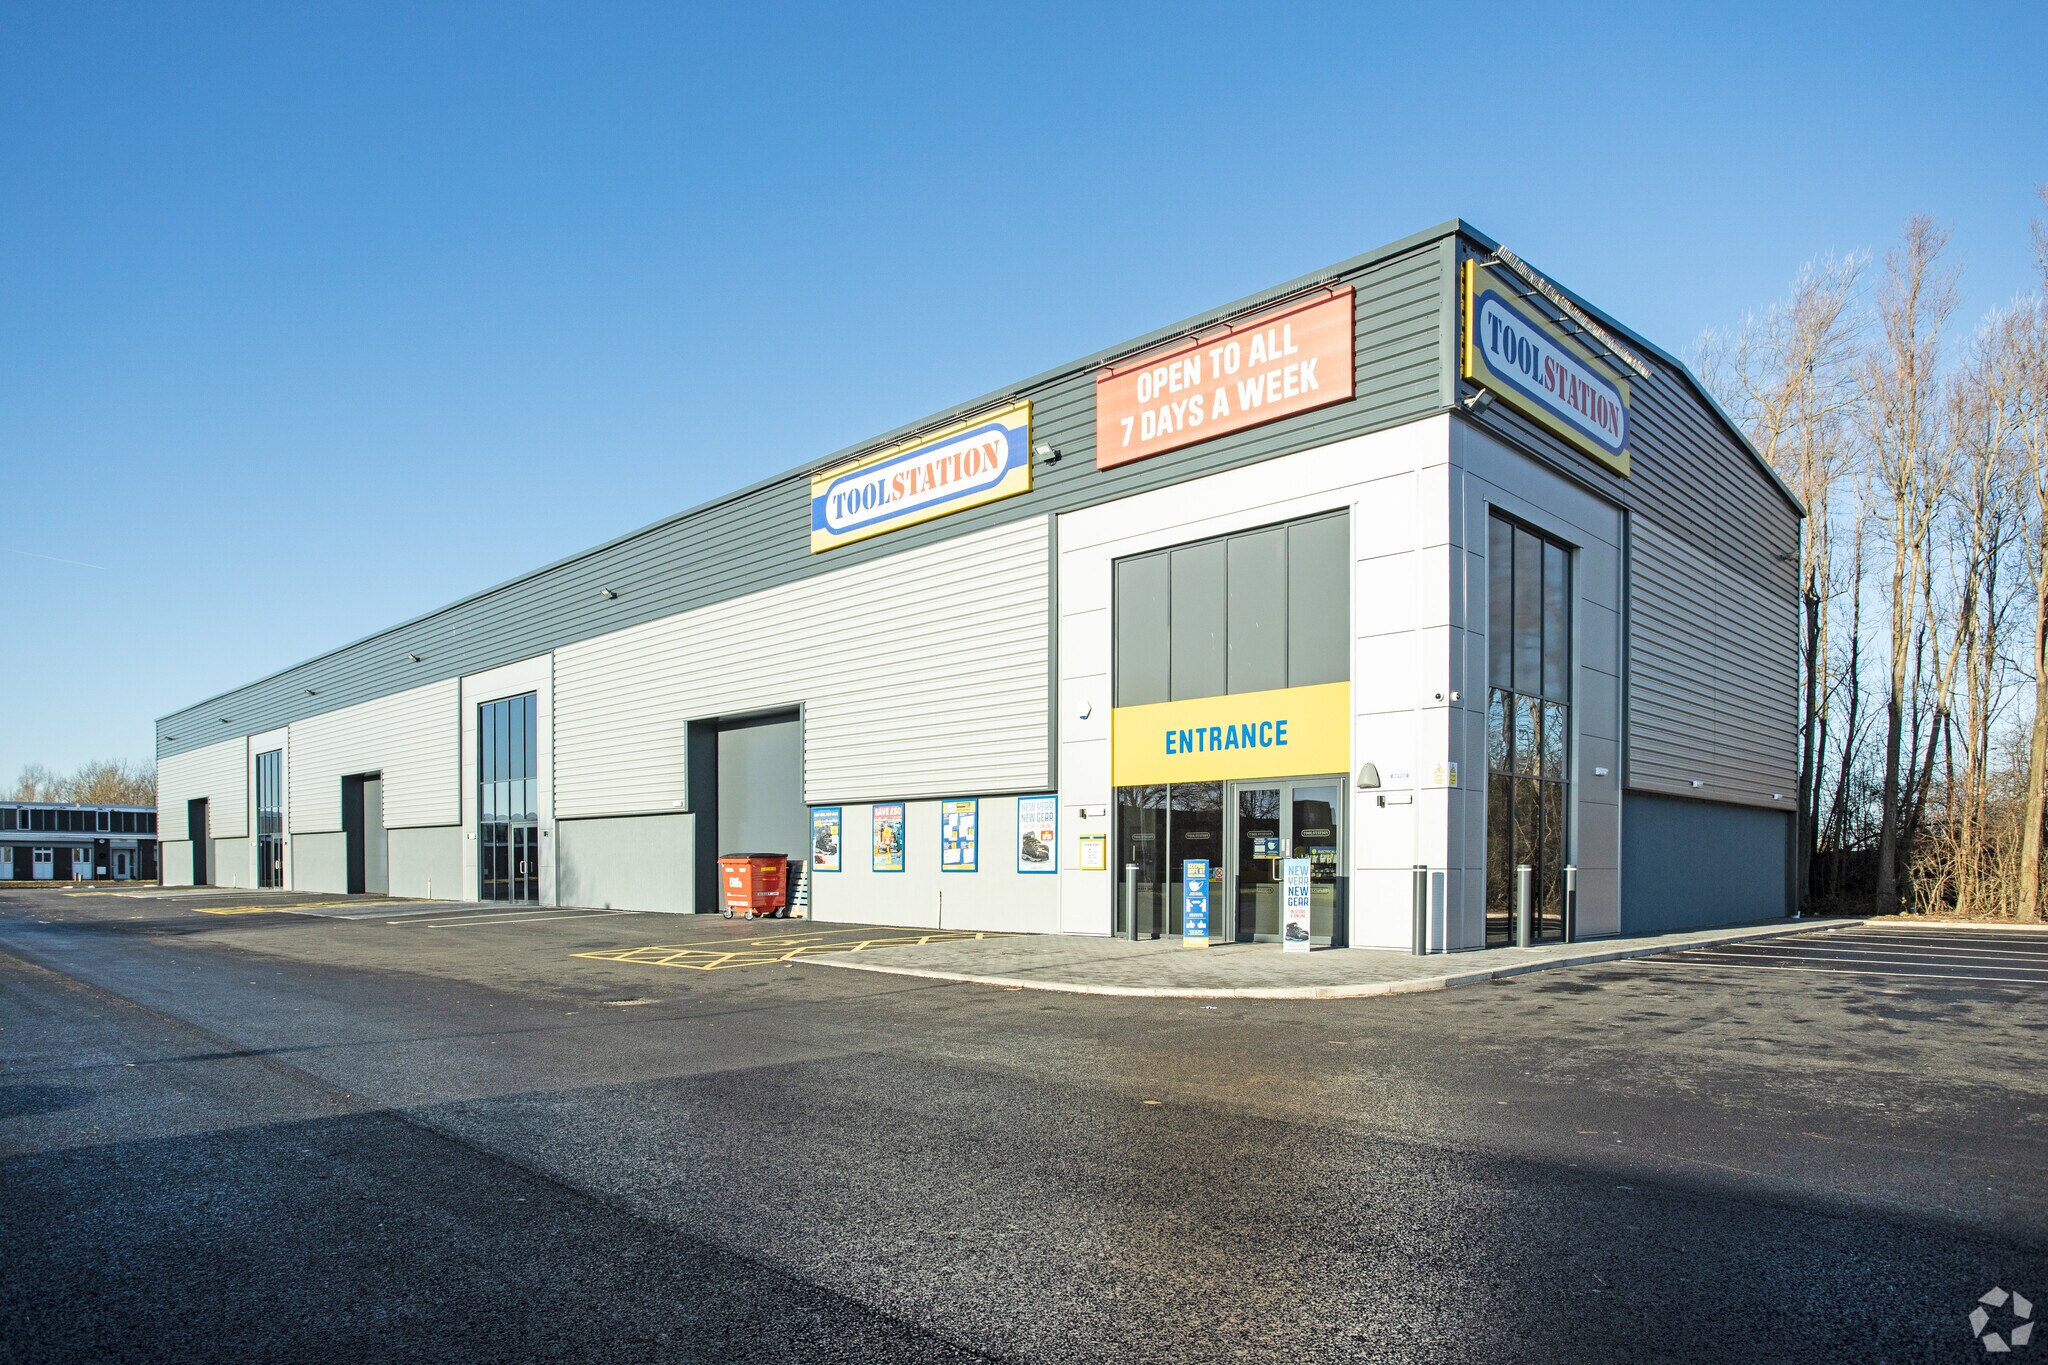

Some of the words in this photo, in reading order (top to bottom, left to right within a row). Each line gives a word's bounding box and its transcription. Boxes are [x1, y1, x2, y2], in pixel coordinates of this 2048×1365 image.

[1137, 354, 1201, 404] OPEN
[1209, 342, 1241, 379] TO
[1248, 323, 1298, 368] ALL
[1488, 311, 1619, 438] TOOLSTATION
[1120, 415, 1134, 447] 7
[1141, 393, 1205, 442] DAYS
[1211, 387, 1230, 421] A
[1237, 357, 1320, 412] WEEK
[833, 439, 1000, 521] TOOLSTATION
[1165, 719, 1288, 755] ENTRANCE
[874, 807, 890, 817] SAVE
[1021, 801, 1036, 812] NEW
[1037, 801, 1054, 811] YEAR
[1021, 812, 1036, 823] NEW
[1036, 811, 1054, 822] GEAR
[1288, 865, 1309, 876] NEW
[1288, 876, 1309, 886] YEAR
[1288, 886, 1309, 897] NEW
[1287, 896, 1309, 907] GEAR
